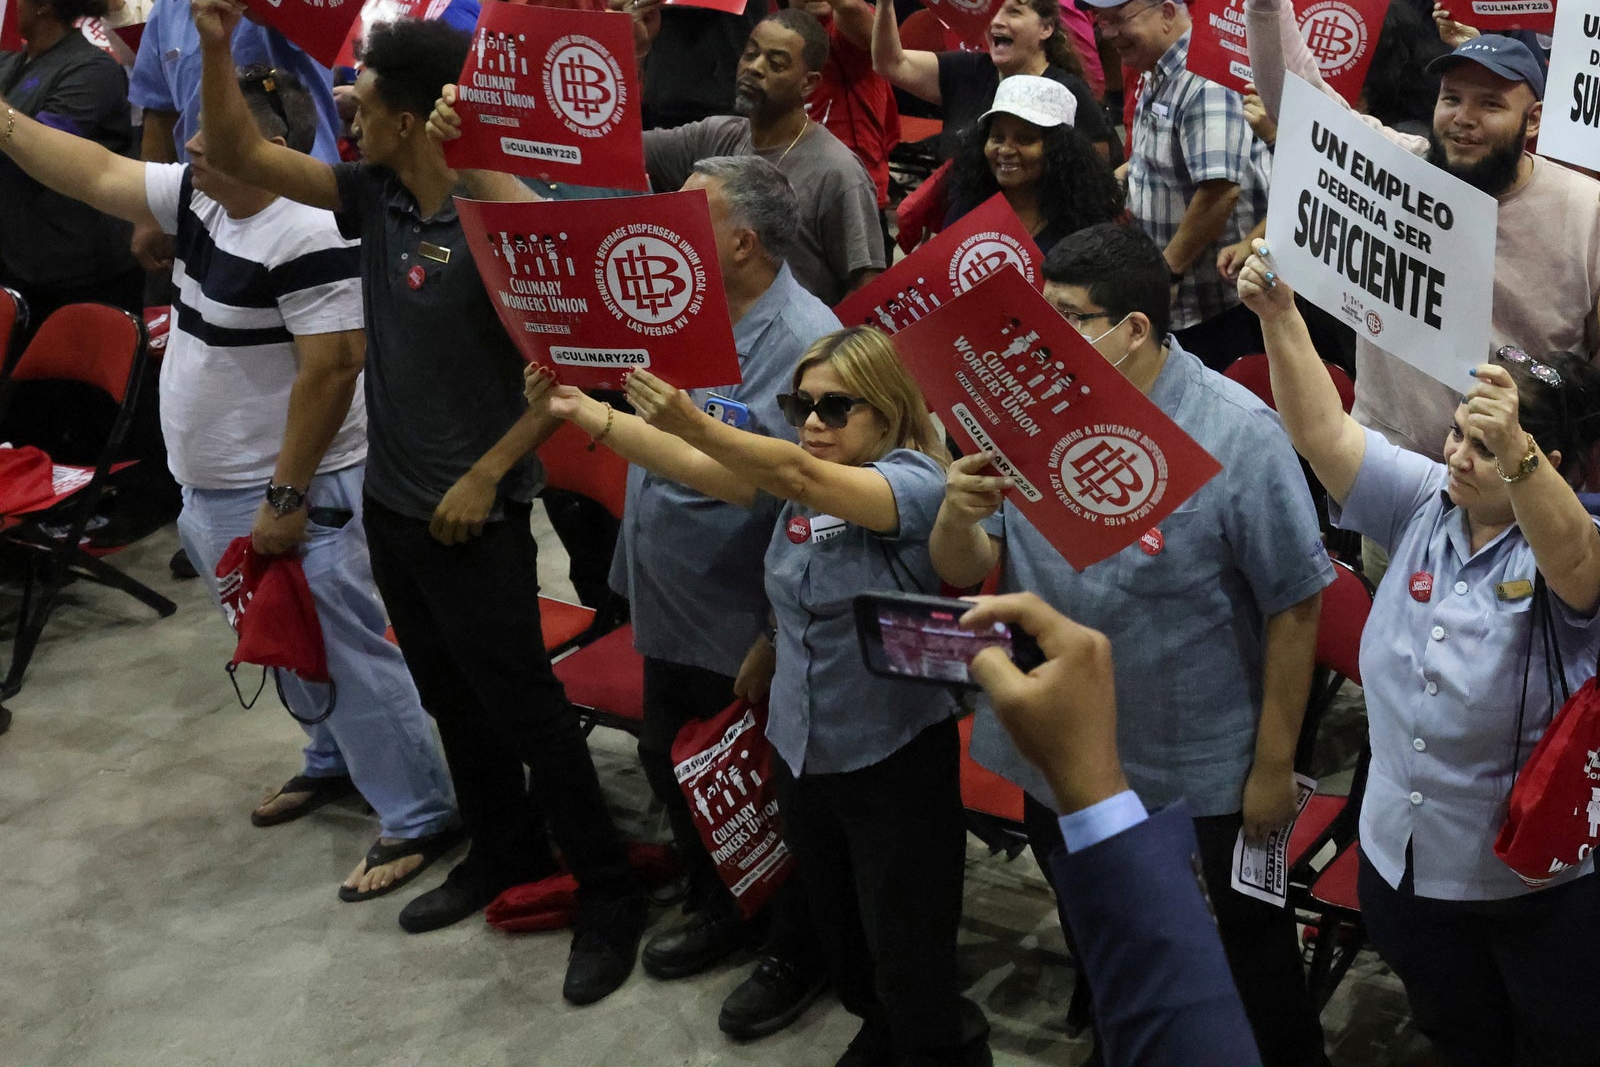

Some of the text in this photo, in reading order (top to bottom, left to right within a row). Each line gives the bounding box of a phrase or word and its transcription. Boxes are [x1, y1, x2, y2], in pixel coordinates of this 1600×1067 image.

[459, 85, 536, 109] WORKERS UNION
[473, 71, 516, 91] CULINARY
[1311, 120, 1454, 231] UN EMPLEO
[1317, 167, 1432, 255] DEBERÍA SER
[594, 223, 706, 321] BARTENDERS BEVERAGE DISPENSERS UNION LOCAL
[1294, 188, 1446, 331] SUFICIENTE
[499, 290, 589, 313] WORKERS UNION
[509, 277, 561, 296] CULINARY
[626, 315, 689, 333] LAS NV
[555, 351, 645, 363] @CULINARY226
[952, 335, 1041, 438] WORKERS UNION
[981, 350, 1038, 409] CULINARY
[1048, 424, 1141, 470] BARTENDERS BEVERAGE
[712, 802, 757, 844] CULINARY
[746, 799, 779, 834] UNION
